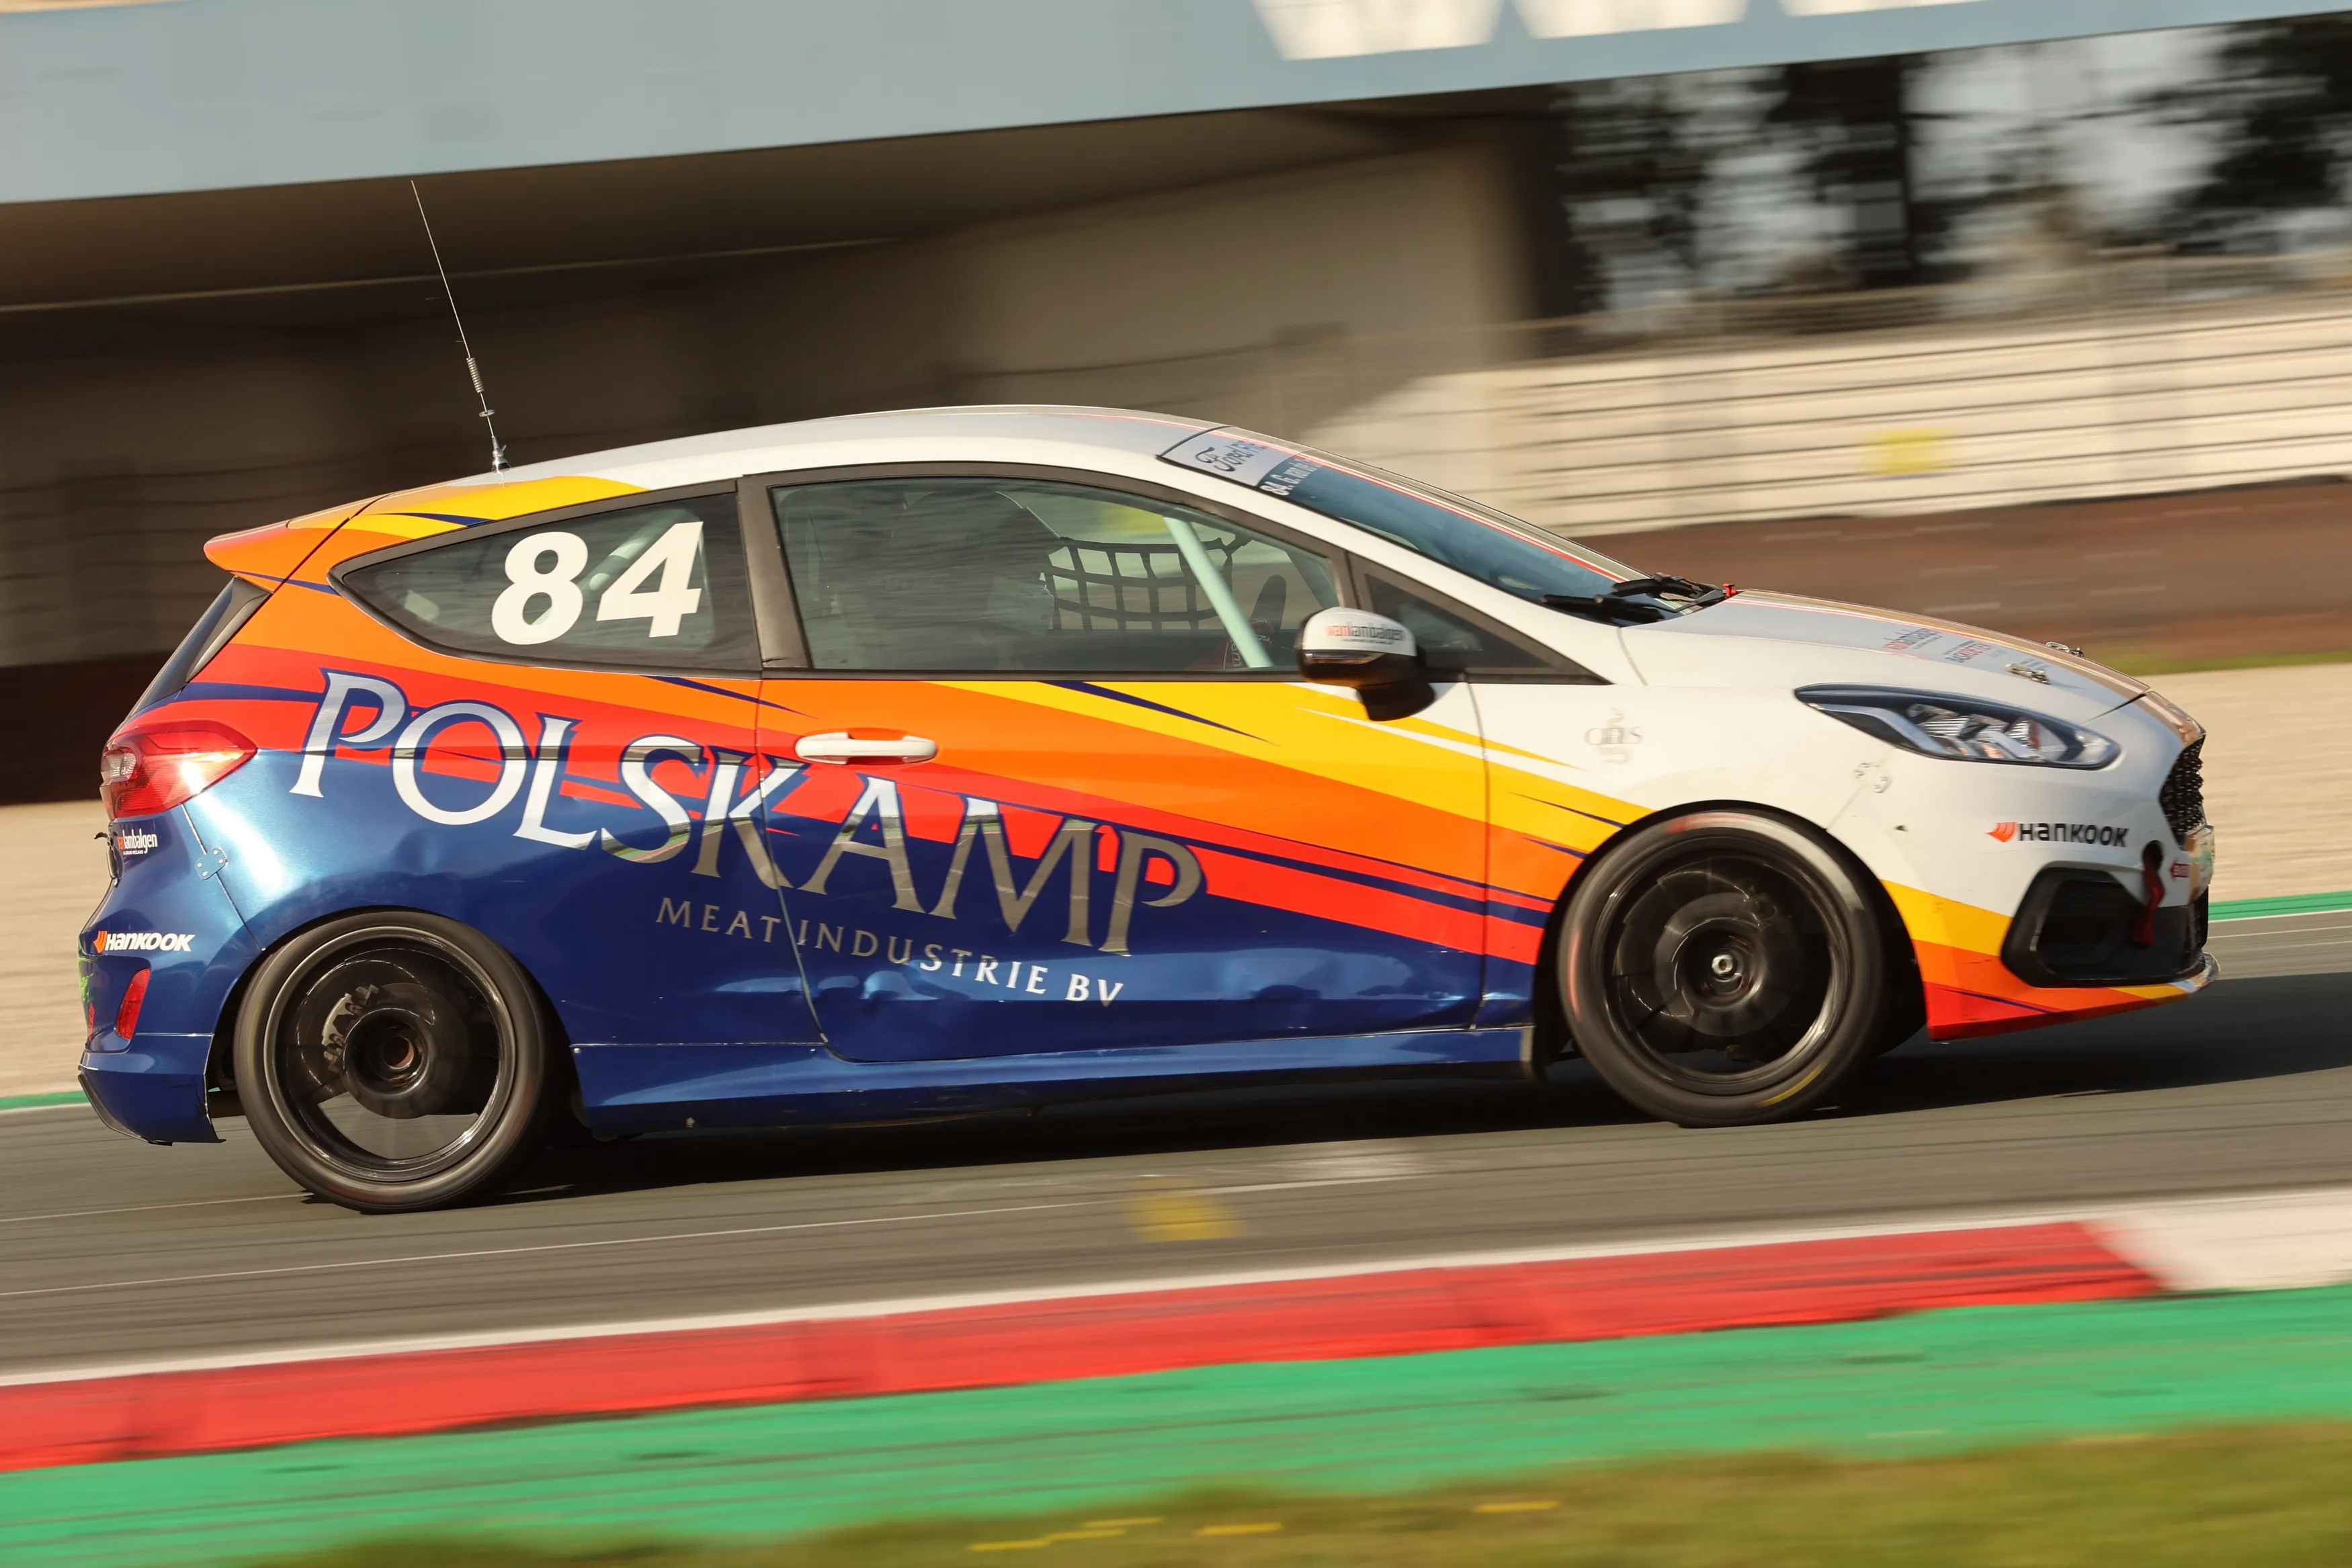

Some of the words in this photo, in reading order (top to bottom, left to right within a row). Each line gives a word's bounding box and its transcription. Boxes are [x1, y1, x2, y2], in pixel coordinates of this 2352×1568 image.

[491, 521, 704, 645] 84
[289, 671, 1203, 957] POLSKAMP
[655, 897, 782, 943] MEAT
[796, 919, 1049, 995] INDUSTRIE
[1064, 973, 1124, 1007] BV
